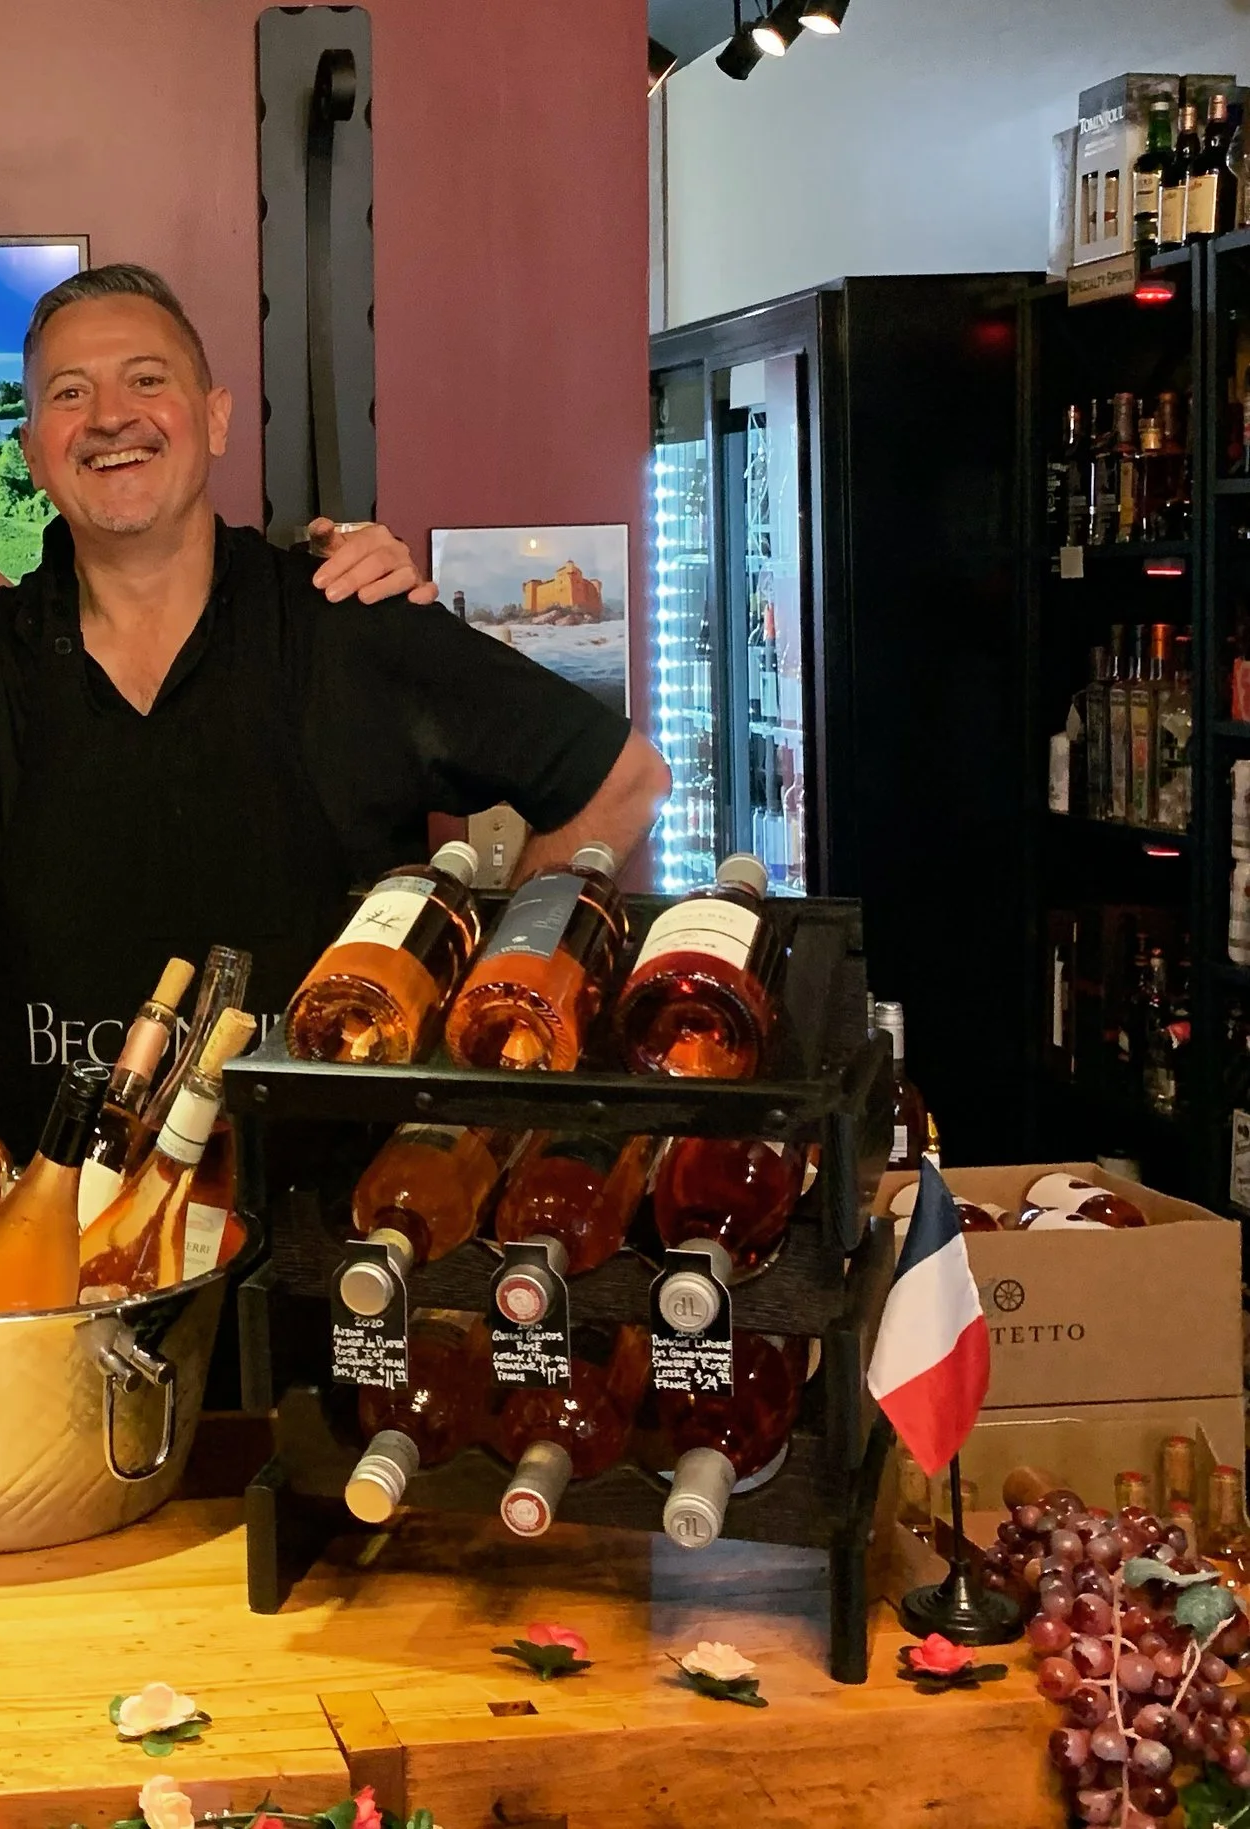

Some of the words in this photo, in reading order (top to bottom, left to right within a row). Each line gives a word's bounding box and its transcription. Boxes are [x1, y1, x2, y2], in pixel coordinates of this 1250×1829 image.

[354, 1316, 385, 1329] 2020
[990, 1323, 1085, 1345] TETTO
[516, 1341, 543, 1352] ROSE
